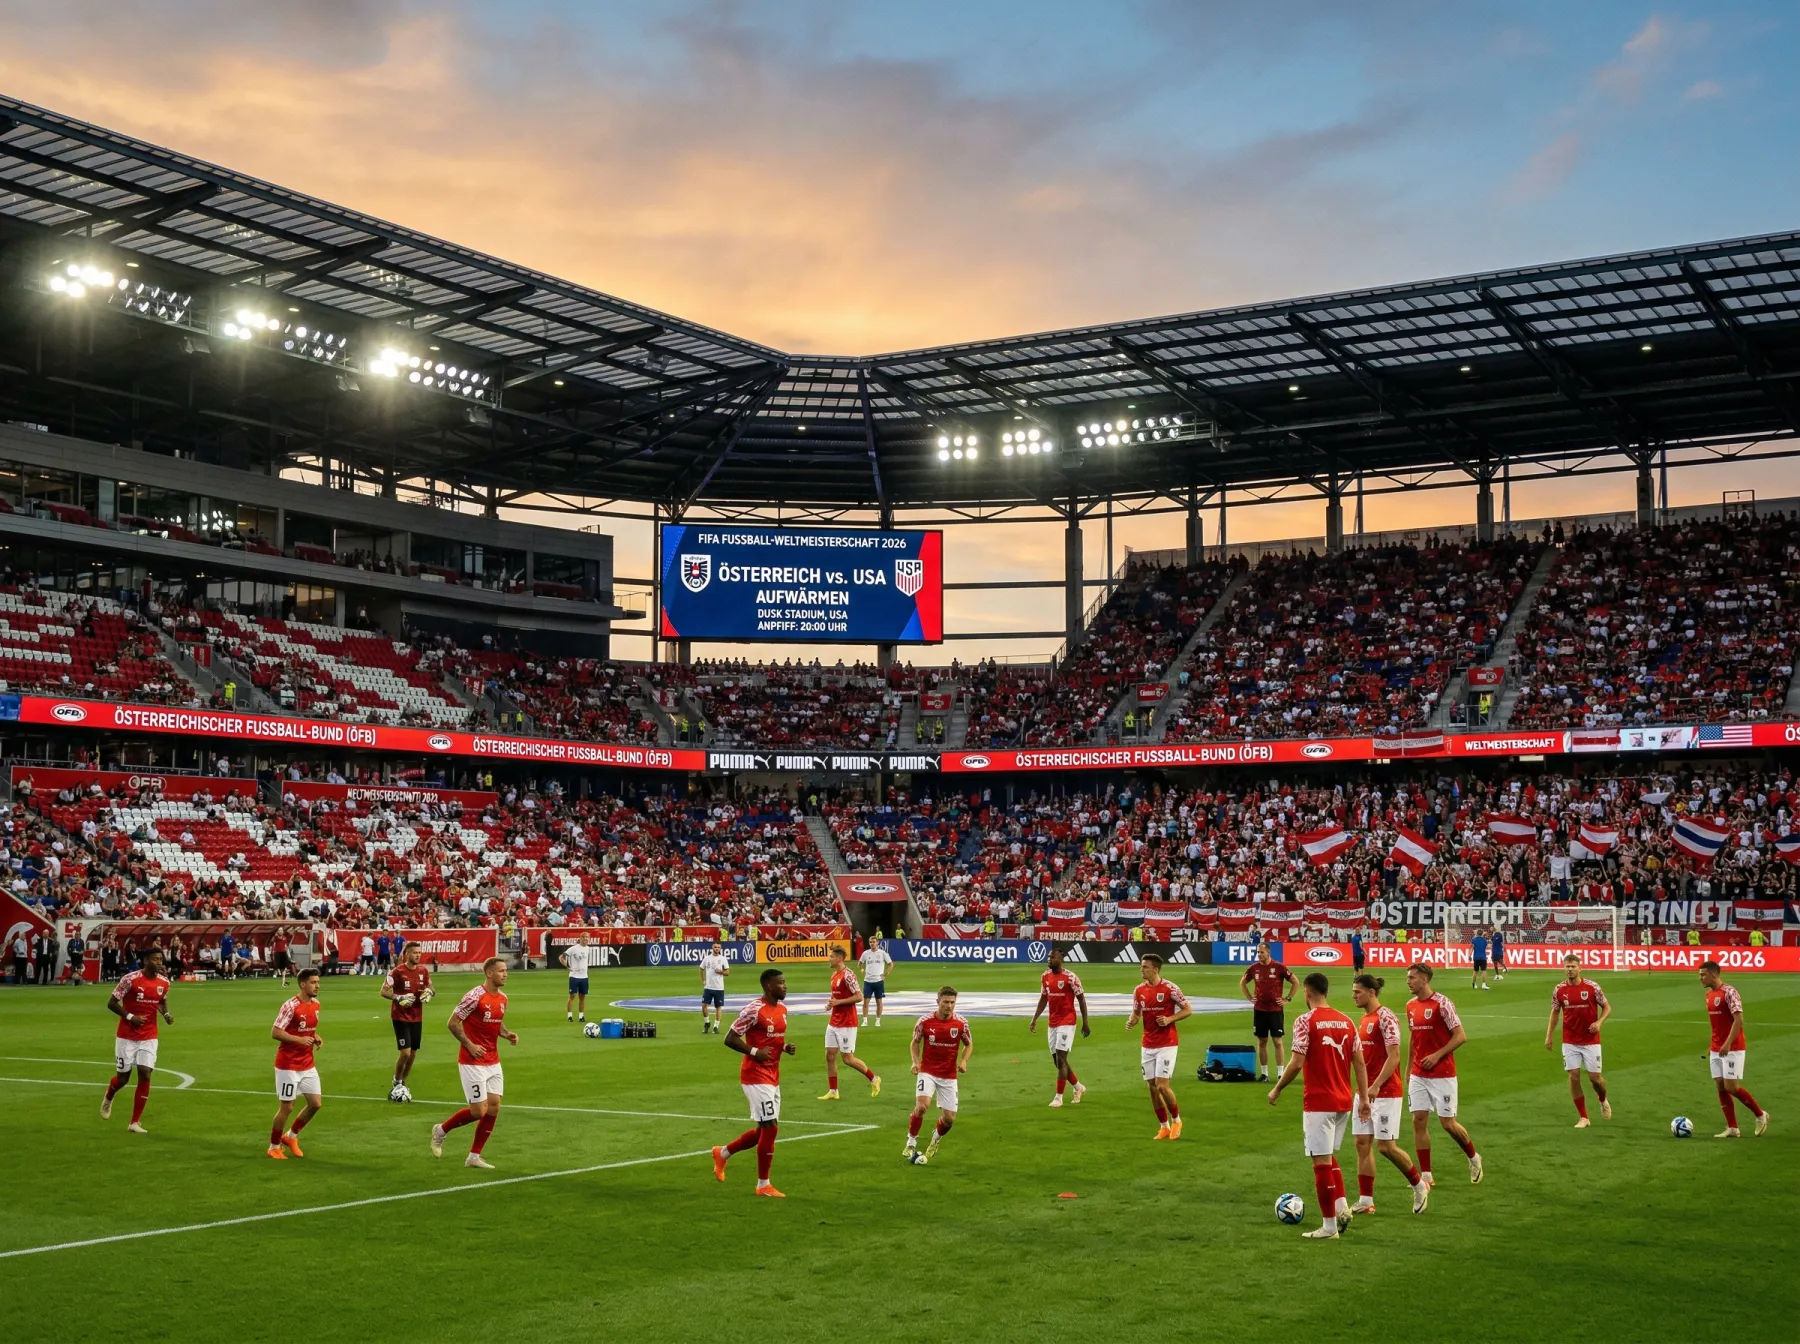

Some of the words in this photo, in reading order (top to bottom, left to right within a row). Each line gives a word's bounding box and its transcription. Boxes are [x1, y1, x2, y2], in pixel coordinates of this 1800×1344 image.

[698, 533, 720, 545] FIFA
[721, 534, 880, 549] FUSSBALL-WELTMEISTERSCHAFT
[881, 538, 907, 549] 2026
[718, 562, 821, 584] ÖSTERREICH
[853, 569, 887, 586] USA
[756, 587, 849, 605] AUFWÄRMEN
[757, 608, 783, 619] DUSK
[785, 609, 827, 620] STADIUM,
[829, 610, 848, 620] USA
[757, 621, 799, 631] ANPFIFF:
[800, 622, 826, 632] 20:00
[827, 622, 848, 632] UHR
[114, 706, 243, 734] ÖSTERREICHISCHER
[246, 720, 344, 742] FUSSBALL-BUND
[346, 721, 376, 746] (ÖFB)
[473, 736, 565, 759] ÖSTERREICHISCHER
[567, 746, 643, 764] FUSSBALL-BUND
[645, 749, 672, 767] (ÖFB)
[1465, 738, 1556, 751] WELTMEISTERSCHAFT
[1015, 751, 1132, 767] ÖSTERREICHISCHER
[1134, 748, 1236, 763] FUSSBALL-BUND
[1239, 744, 1273, 761] (ÖFB)
[1371, 899, 1524, 925] ÖSTERREICH
[665, 944, 738, 962] Volkswen
[907, 941, 1018, 963] Volkswagen
[1368, 947, 1406, 963] FIFA
[1411, 948, 1493, 965] PARTNR
[1506, 949, 1712, 967] WELTMEISTERSCHAFT
[1719, 950, 1765, 967] 2026
[281, 1083, 294, 1097] 10
[472, 1084, 481, 1099] 3
[761, 1100, 775, 1117] 13
